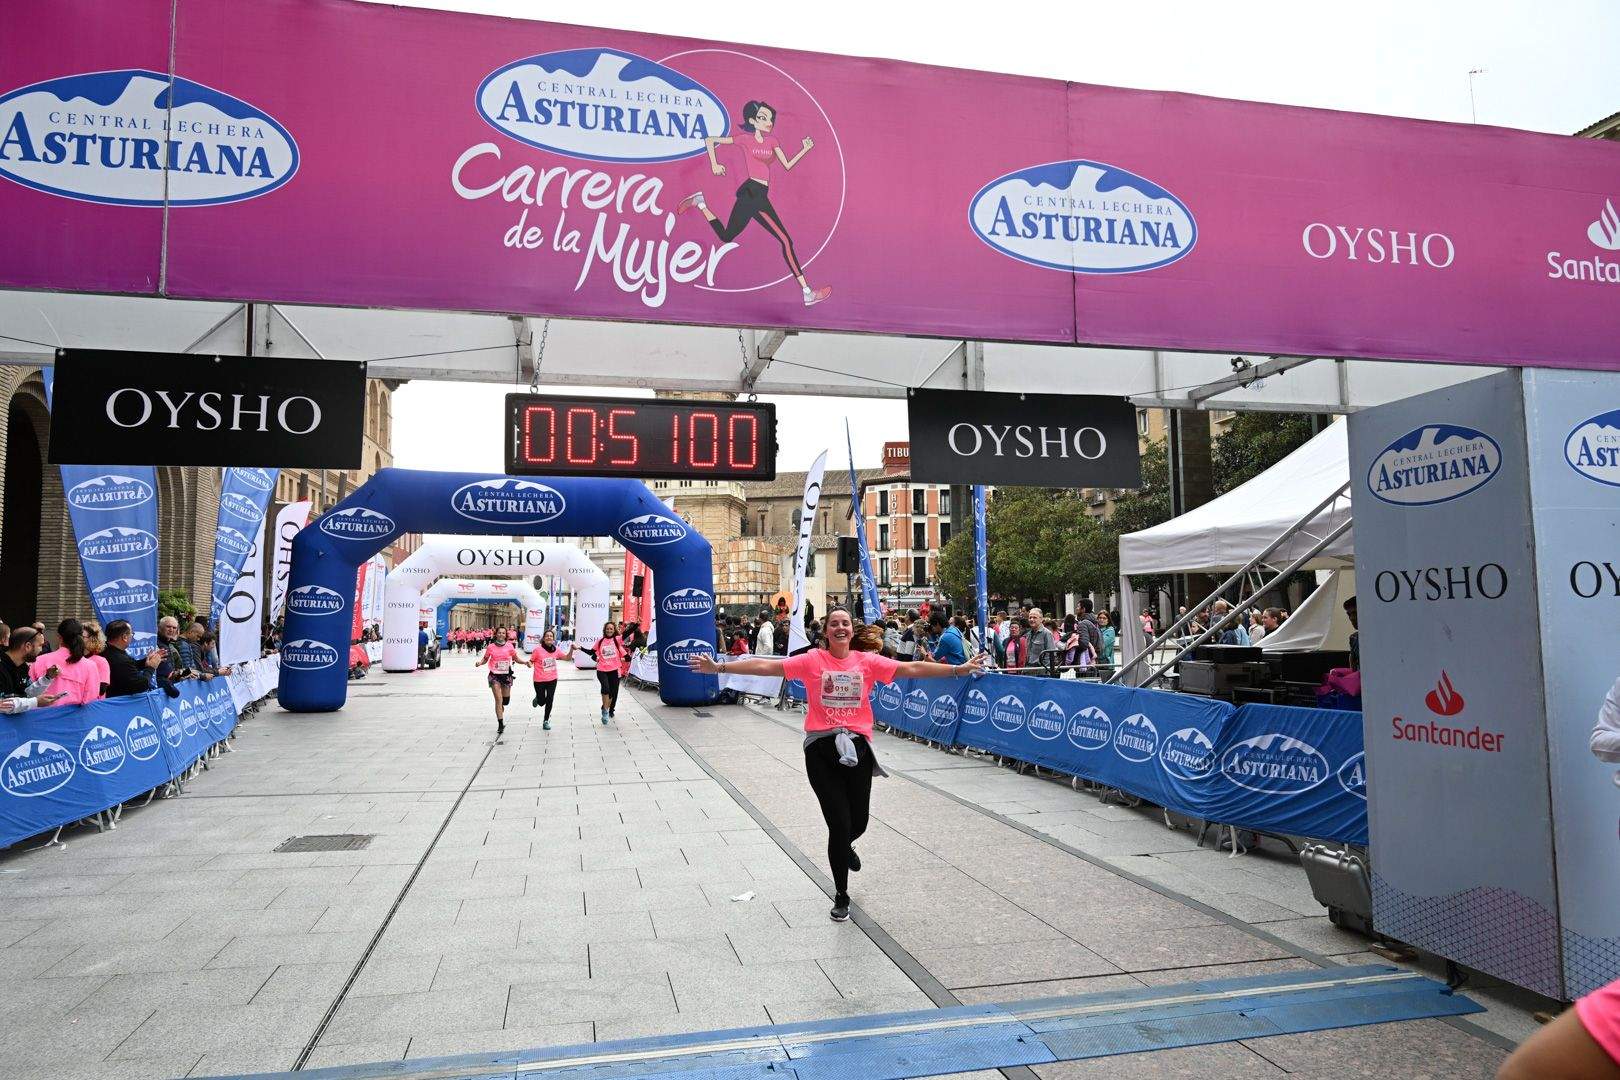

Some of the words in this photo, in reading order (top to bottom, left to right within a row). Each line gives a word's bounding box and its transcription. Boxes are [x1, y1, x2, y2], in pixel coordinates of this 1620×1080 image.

[538, 81, 617, 99] CENTRAL
[625, 90, 704, 107] LECHERA
[496, 80, 710, 140] ASTURIANA
[48, 111, 151, 130] CENTRAL
[163, 120, 265, 139] LECHERA
[0, 111, 275, 178] ASTURIANA
[451, 142, 664, 216] Carrera
[1024, 194, 1096, 210] CENTRAL
[1102, 200, 1173, 216] LECHERA
[987, 195, 1182, 249] ASTURIANA
[504, 208, 544, 249] de
[552, 211, 582, 253] la
[575, 212, 740, 308] Mujer
[1302, 222, 1456, 268] OYSHO
[1547, 251, 1620, 283] Santa
[105, 387, 323, 435] OYSHO
[887, 447, 909, 458] TIBU
[948, 422, 1107, 460] OYSHO
[1392, 451, 1435, 467] CENTRAL
[1437, 441, 1485, 459] LECHERA
[1375, 453, 1492, 493] ASTURIANA
[459, 491, 558, 514] ASTURIANA
[478, 490, 515, 498] CENTRAL
[517, 491, 554, 499] LECHERA
[324, 518, 389, 533] ASTURIANA
[624, 526, 682, 538] ASTURIANA
[456, 548, 545, 567] OYSHO
[1374, 562, 1509, 603] OYSHO
[288, 595, 340, 609] ASTURIANA
[665, 599, 711, 610] ASTURIANA
[283, 649, 333, 663] ASTURIANA
[1069, 719, 1108, 743] ASTURIANA
[1116, 727, 1154, 753] ASTURIANA
[1392, 717, 1505, 753] Santander
[85, 744, 124, 767] ASTURIANA
[1225, 751, 1319, 783] ASTURIANA
[8, 759, 72, 789] ASTURIANA
